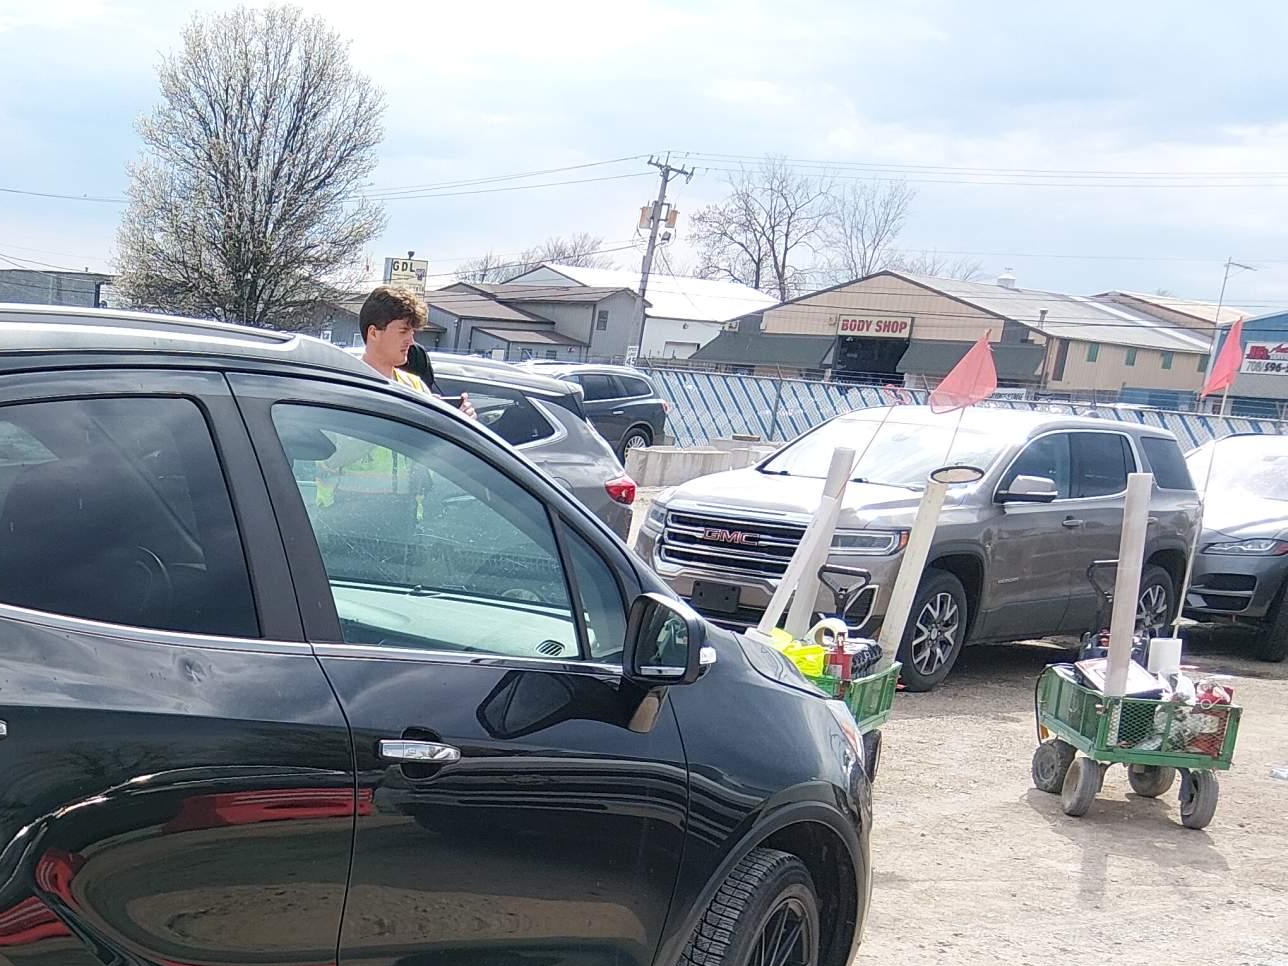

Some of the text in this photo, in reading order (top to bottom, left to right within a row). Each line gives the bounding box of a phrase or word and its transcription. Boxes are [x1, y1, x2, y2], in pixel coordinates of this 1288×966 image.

[392, 260, 415, 273] GDL
[841, 319, 908, 334] BODY SHOP
[704, 528, 760, 546] GMC
